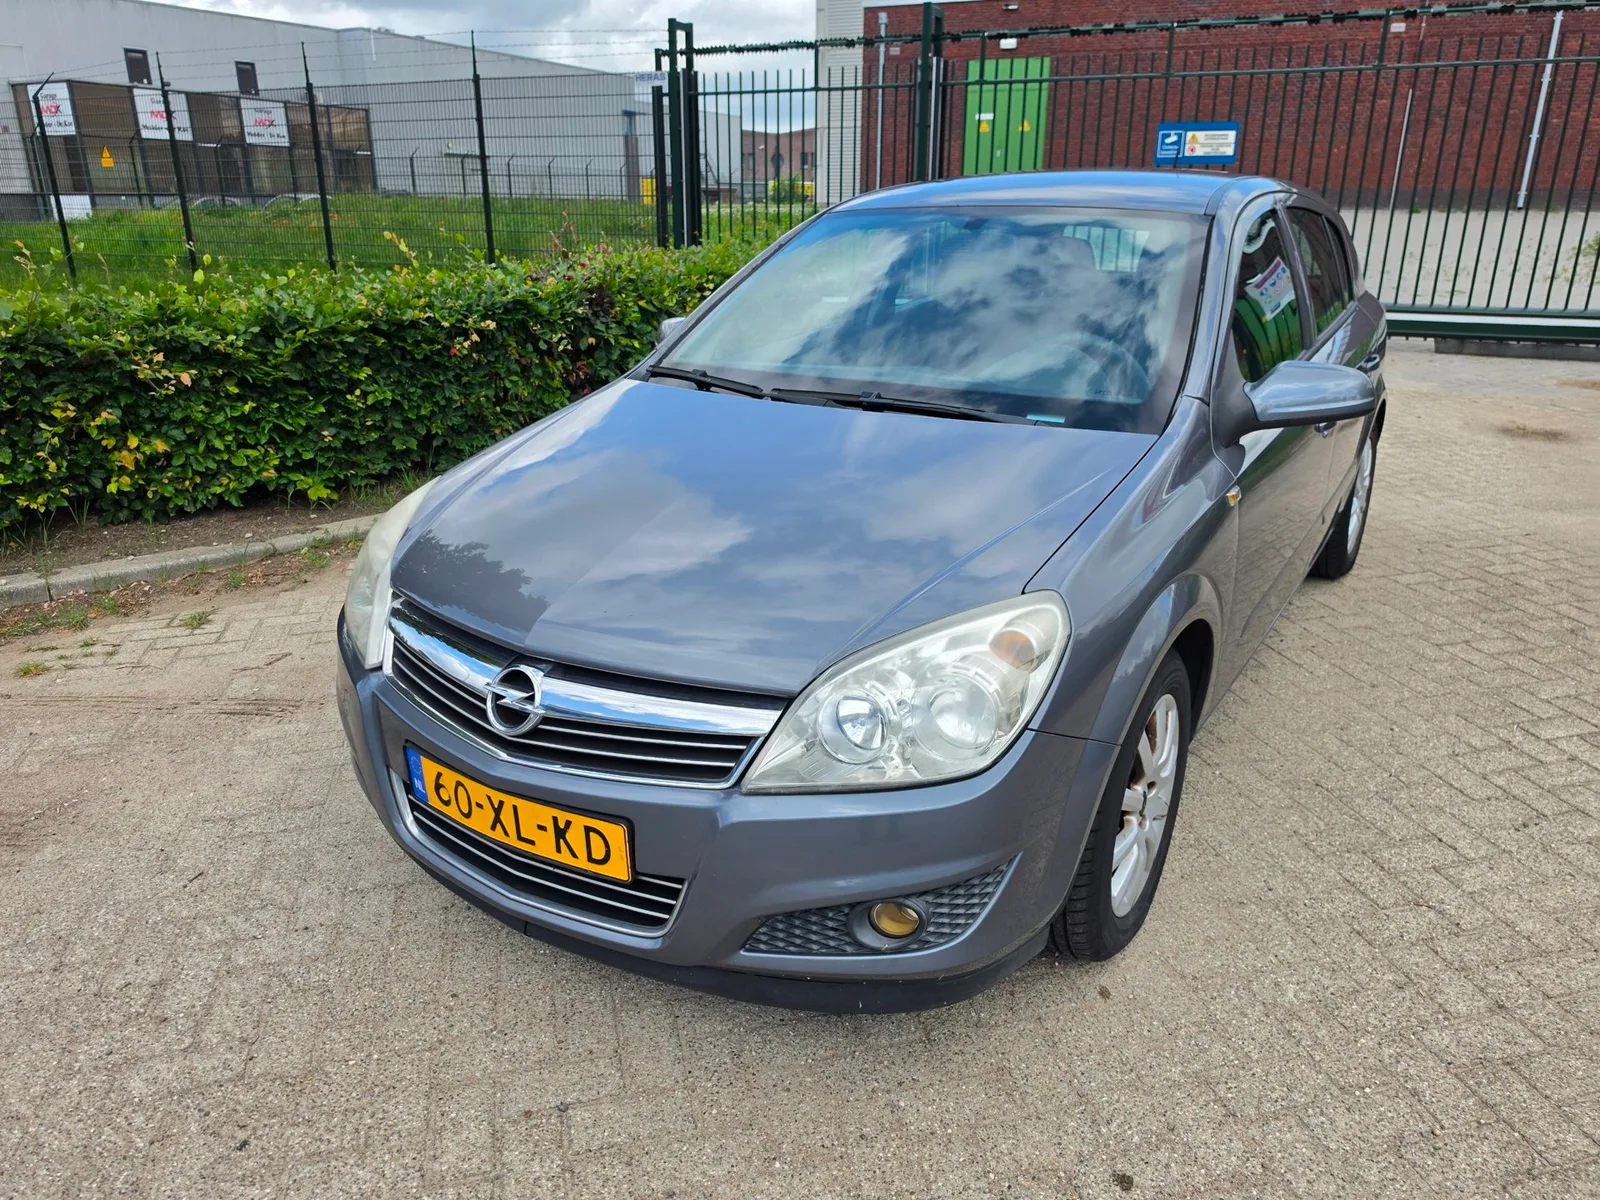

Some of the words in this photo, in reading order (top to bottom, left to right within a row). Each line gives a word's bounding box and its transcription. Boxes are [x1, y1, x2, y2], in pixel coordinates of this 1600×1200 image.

[636, 73, 666, 81] HERAS
[414, 777, 426, 794] NL
[434, 771, 611, 865] 60-XL-KD
